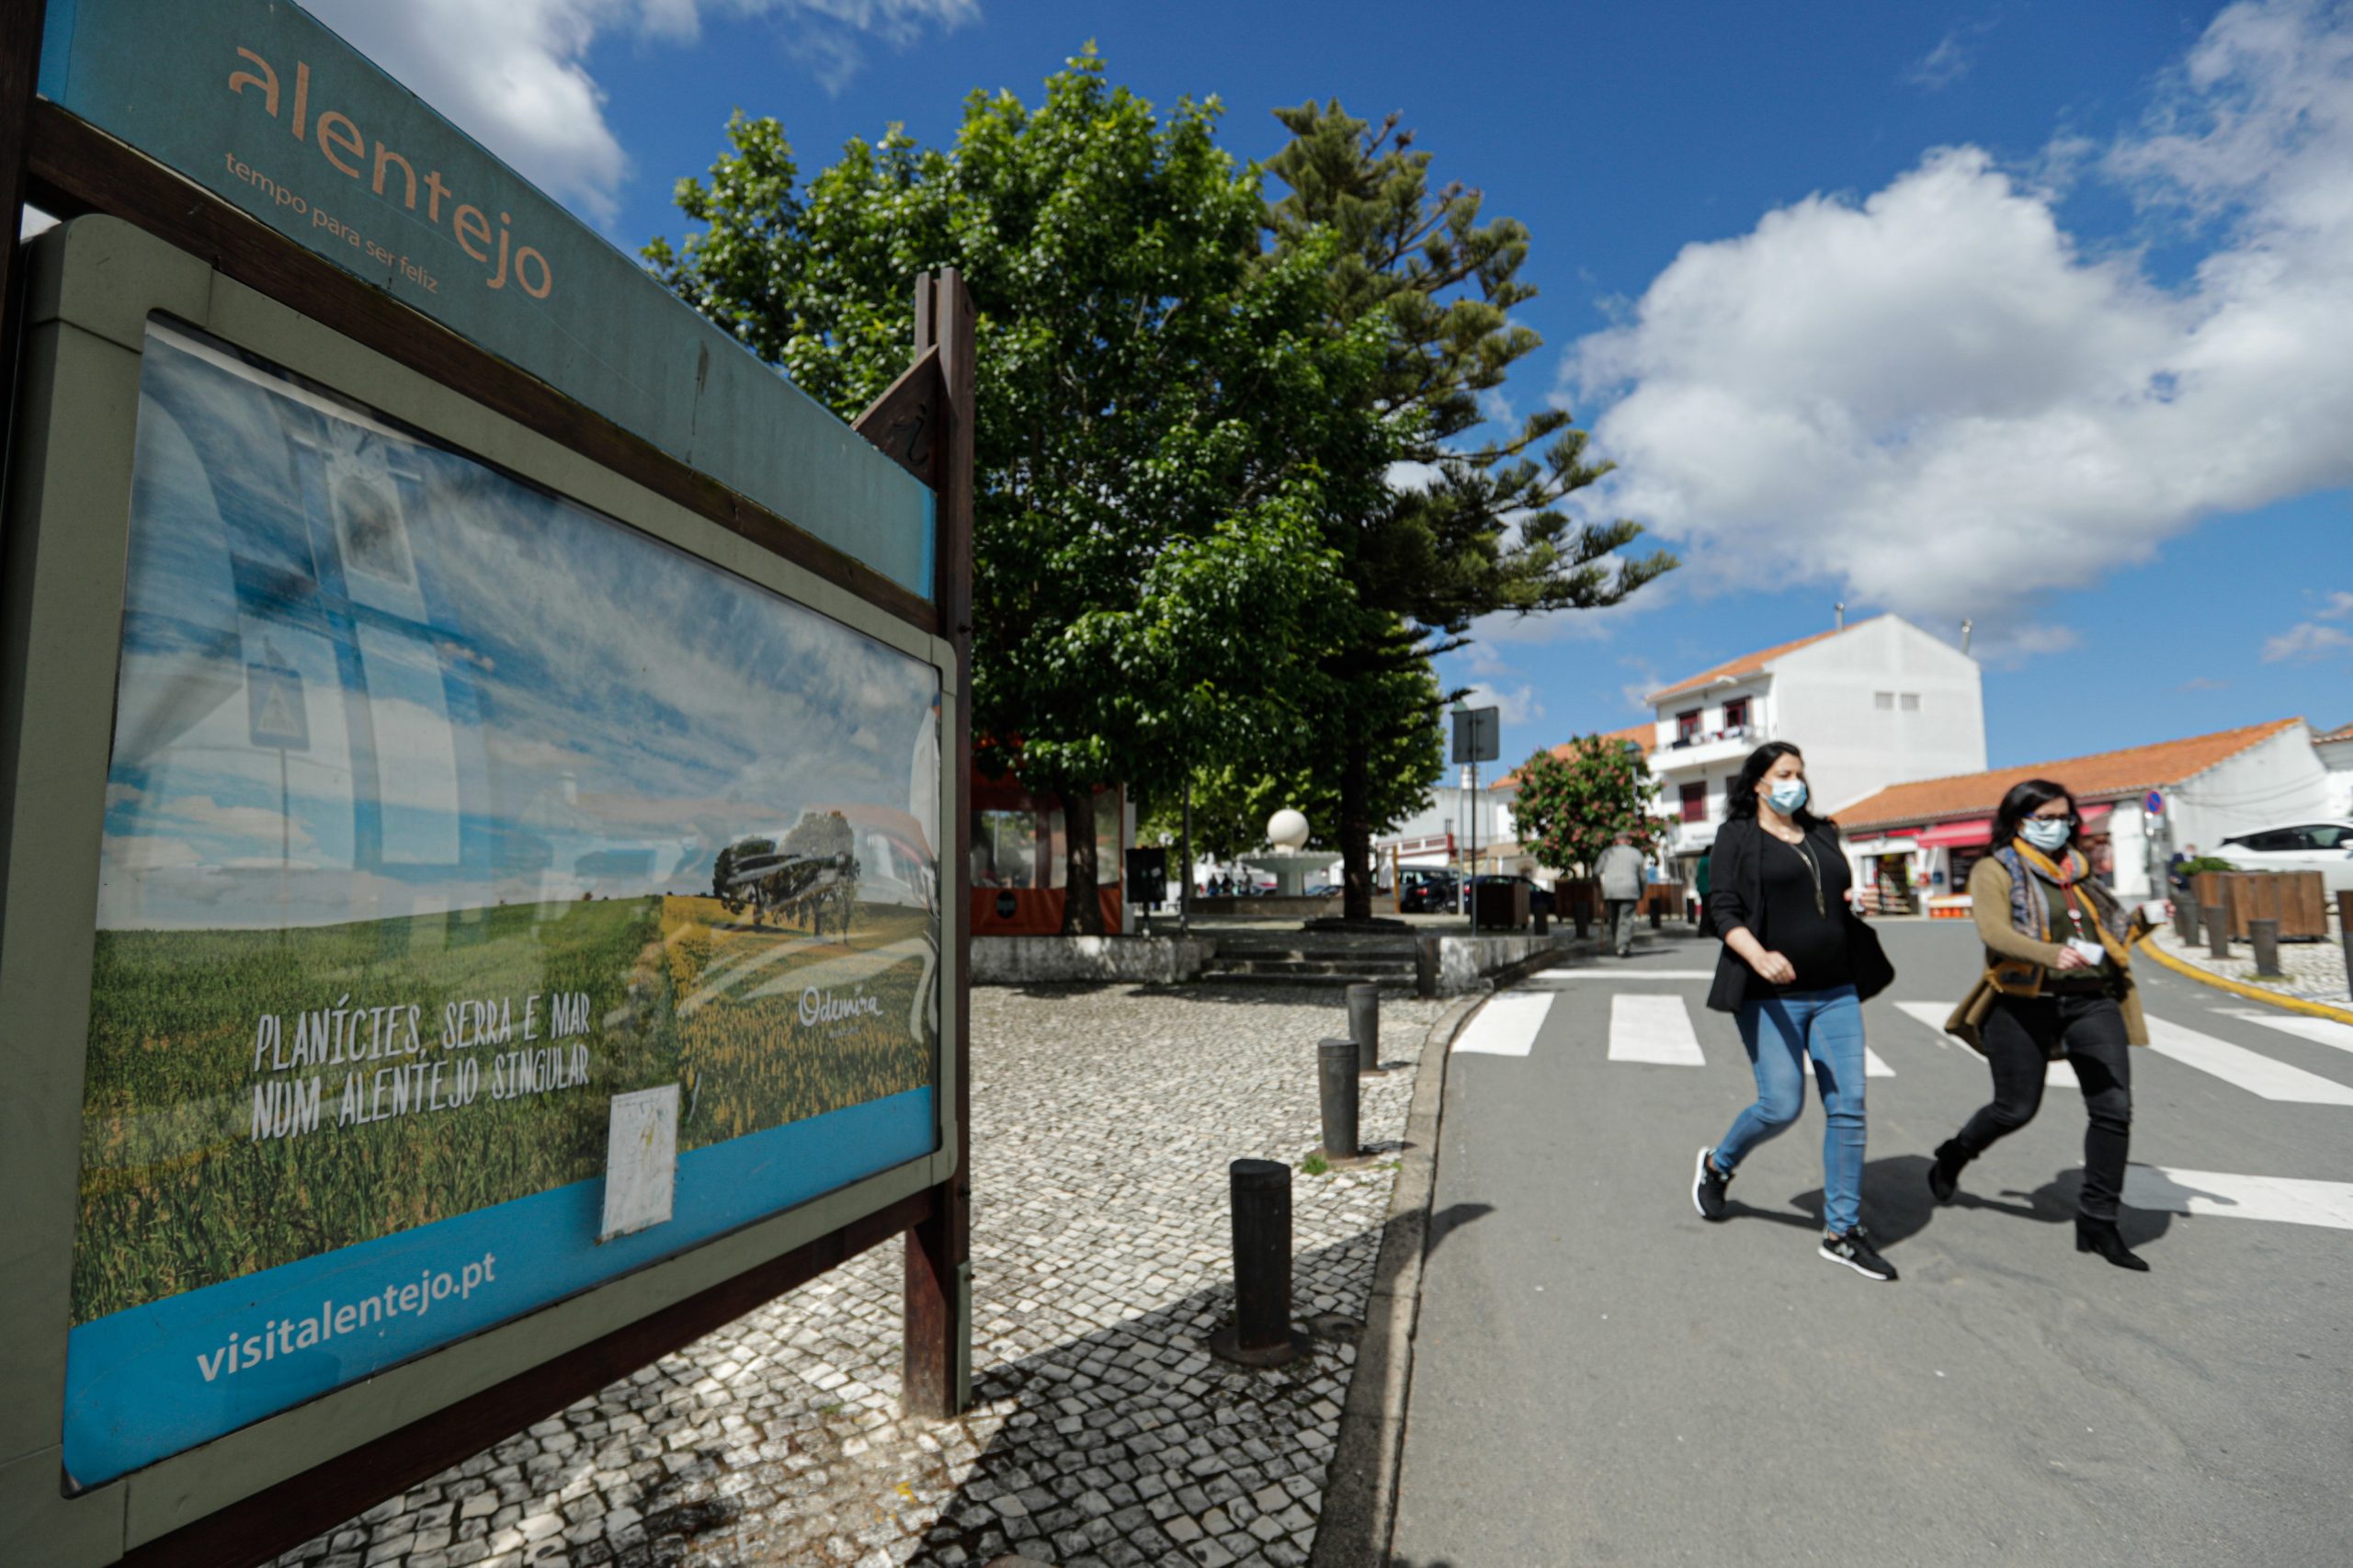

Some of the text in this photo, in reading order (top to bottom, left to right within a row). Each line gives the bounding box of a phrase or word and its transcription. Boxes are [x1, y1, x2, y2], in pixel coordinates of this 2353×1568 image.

[225, 153, 438, 294] tempo para ser feliz
[229, 46, 552, 299] alentejo
[254, 992, 590, 1073] PLANÍCIES, SERRA E MAR
[798, 984, 883, 1027] Odemira
[251, 1043, 589, 1142] NUM ALENTEJO SINGULAR
[196, 1252, 496, 1382] visitalentejo.pt
